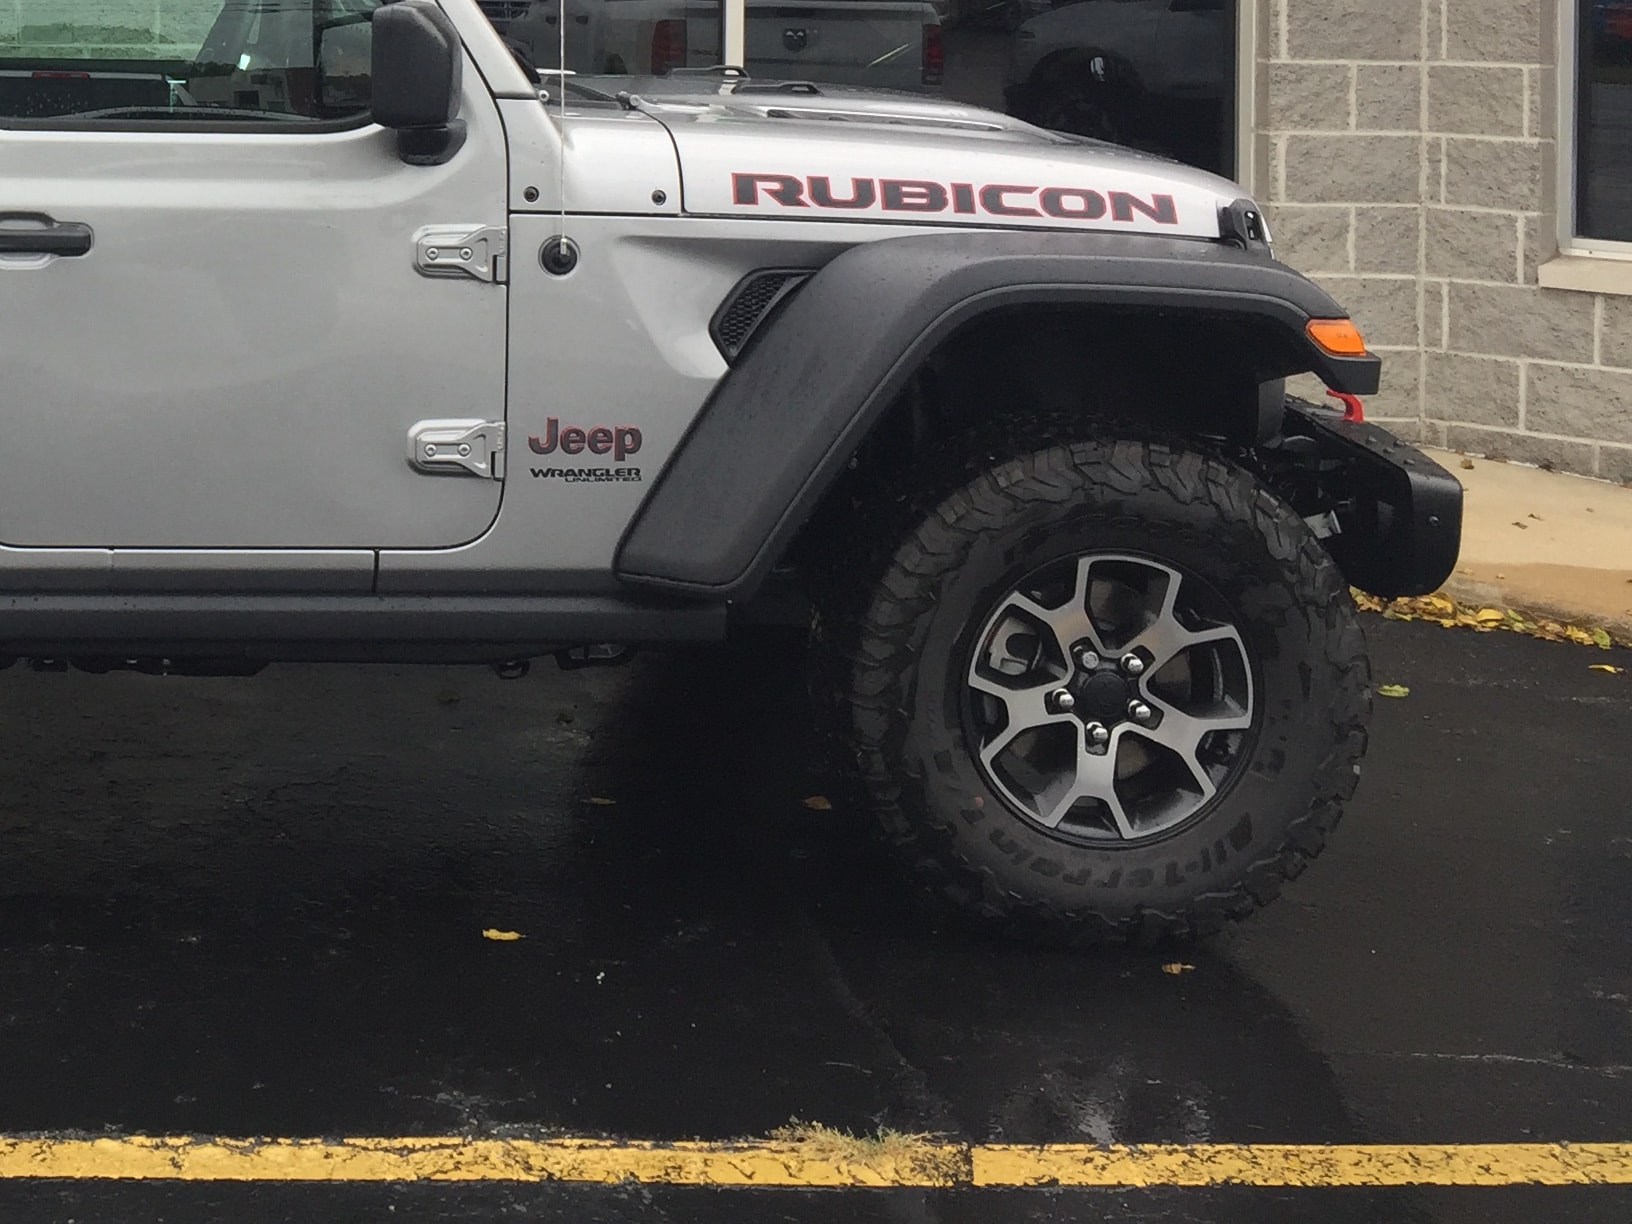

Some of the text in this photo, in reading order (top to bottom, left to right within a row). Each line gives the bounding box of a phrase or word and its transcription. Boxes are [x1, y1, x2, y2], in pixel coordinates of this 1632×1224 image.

[731, 172, 1179, 225] RUBICON
[528, 417, 642, 461] Jeep
[529, 467, 641, 477] WRANGLER
